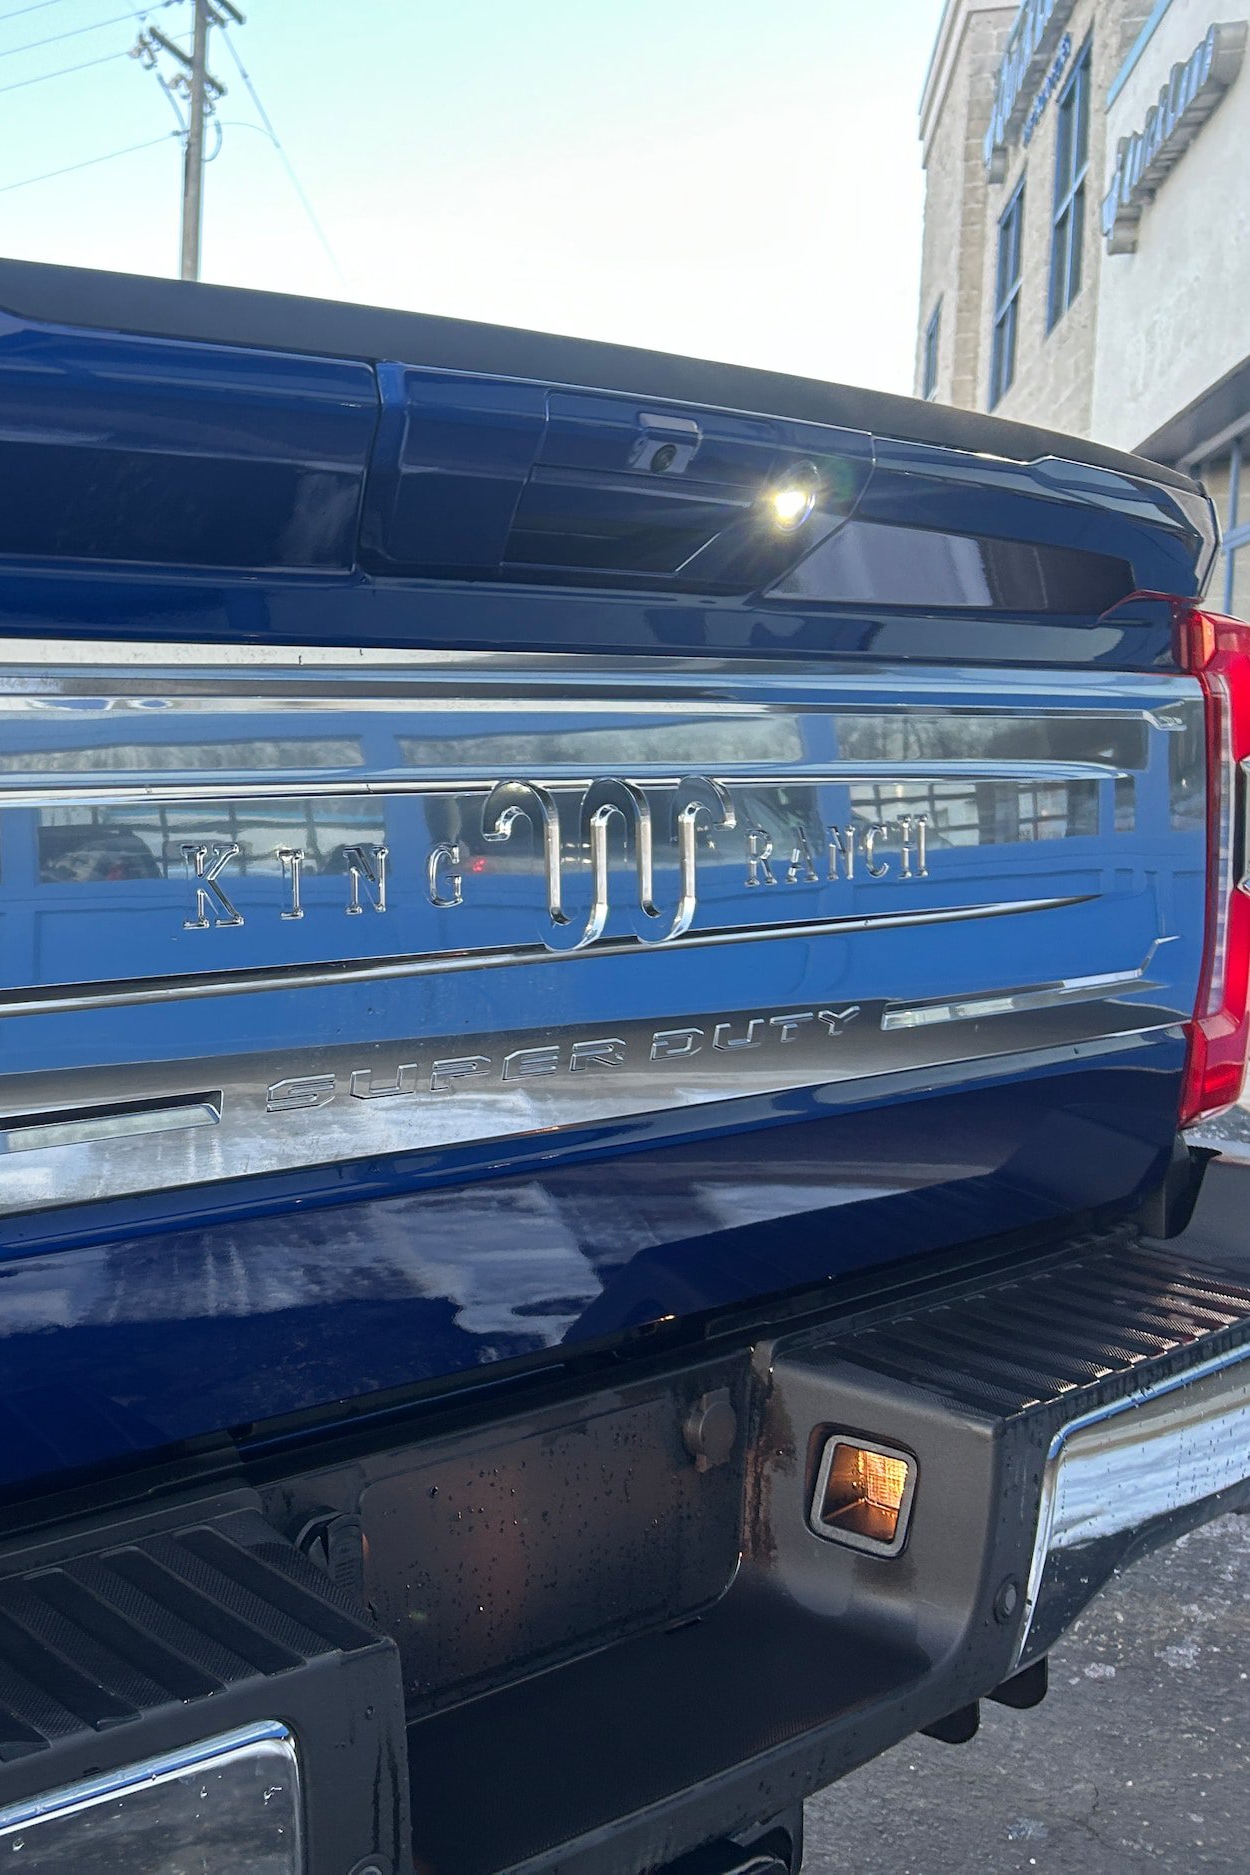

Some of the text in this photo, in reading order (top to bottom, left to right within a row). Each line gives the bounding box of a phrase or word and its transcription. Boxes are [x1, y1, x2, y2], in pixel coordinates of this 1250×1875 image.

[181, 811, 929, 930] KING RANCH
[266, 1005, 862, 1113] SUPER DUTY
